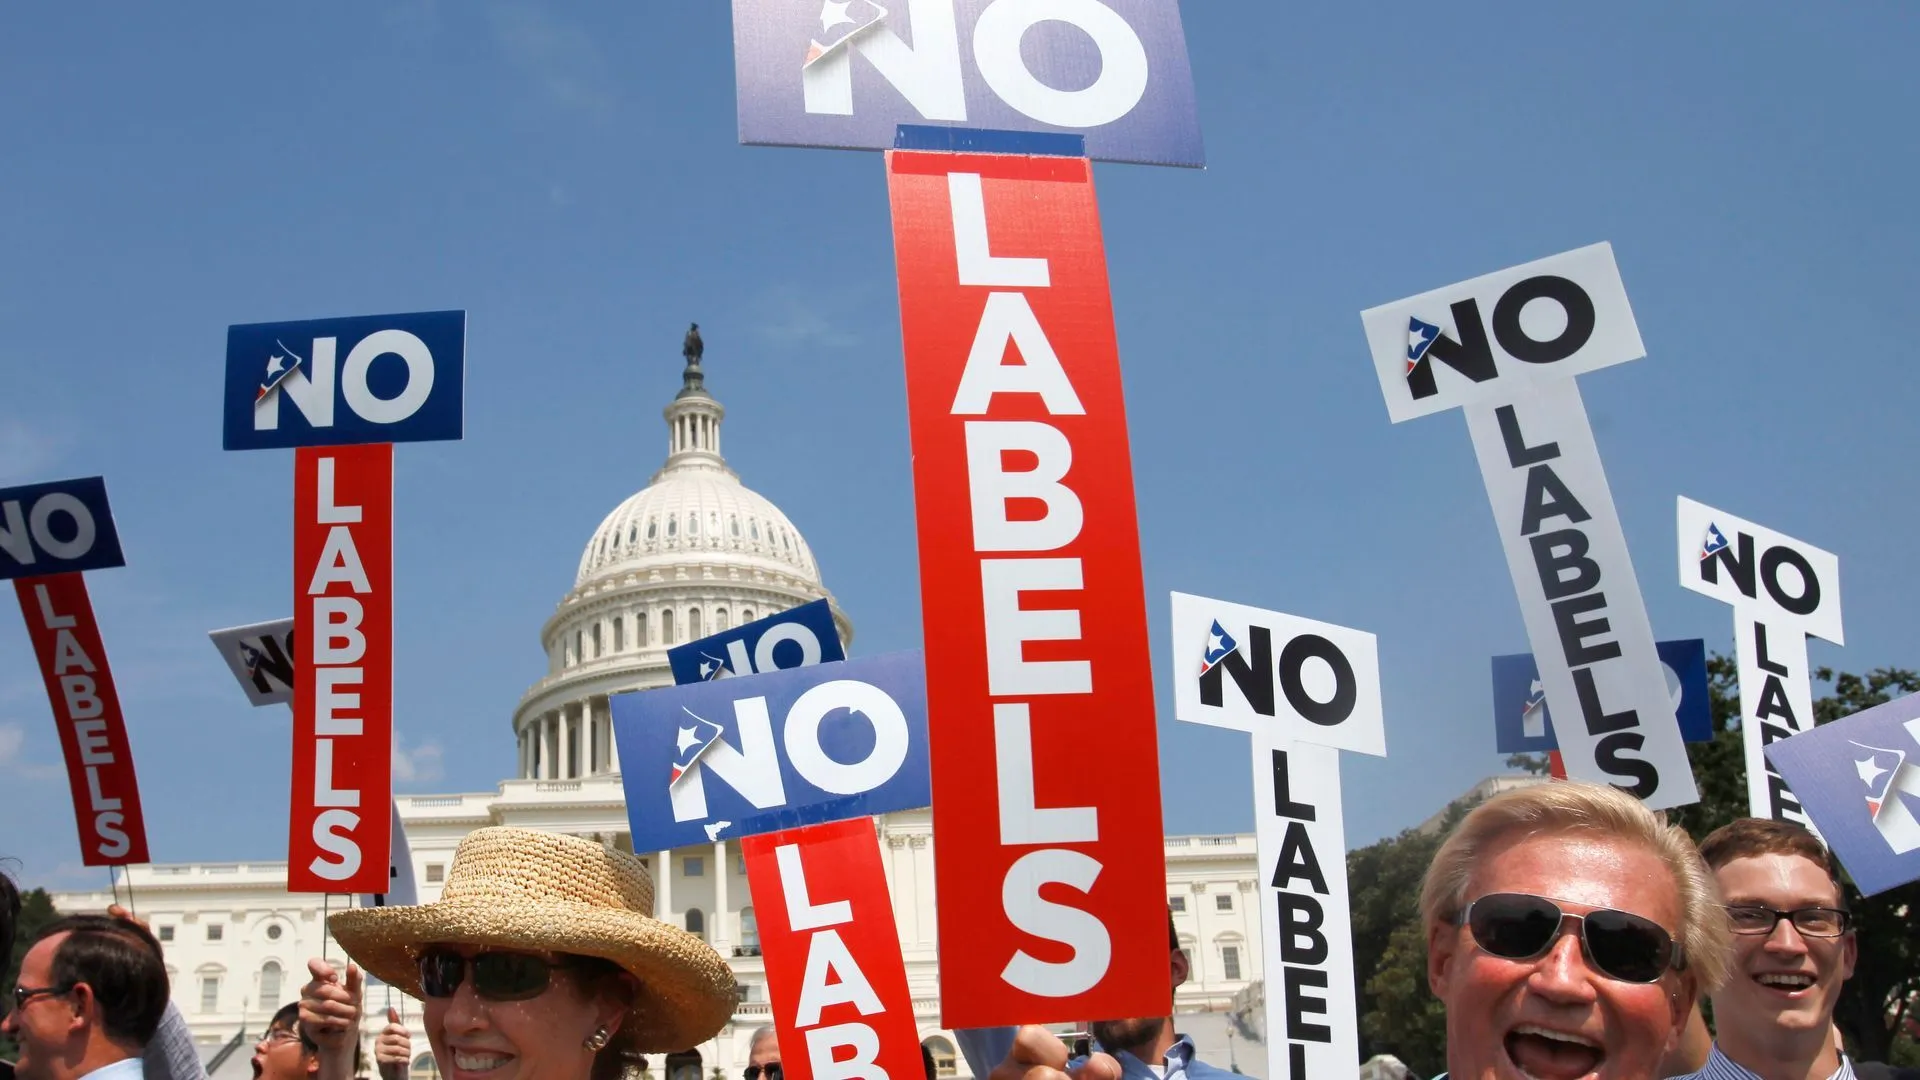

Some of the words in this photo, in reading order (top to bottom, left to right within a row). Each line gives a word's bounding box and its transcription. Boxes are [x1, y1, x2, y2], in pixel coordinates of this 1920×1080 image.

[803, 0, 1148, 127] NO
[254, 329, 435, 430] NO
[1406, 275, 1595, 400] NO
[947, 172, 1112, 997] LABELS
[1495, 405, 1659, 800] LABELS
[1700, 522, 1821, 615] NO
[34, 584, 131, 858] LABELS
[239, 629, 294, 694] N
[308, 456, 373, 881] LABELS
[1199, 618, 1357, 726] NO
[669, 679, 909, 823] NO
[775, 843, 891, 1080] LAB
